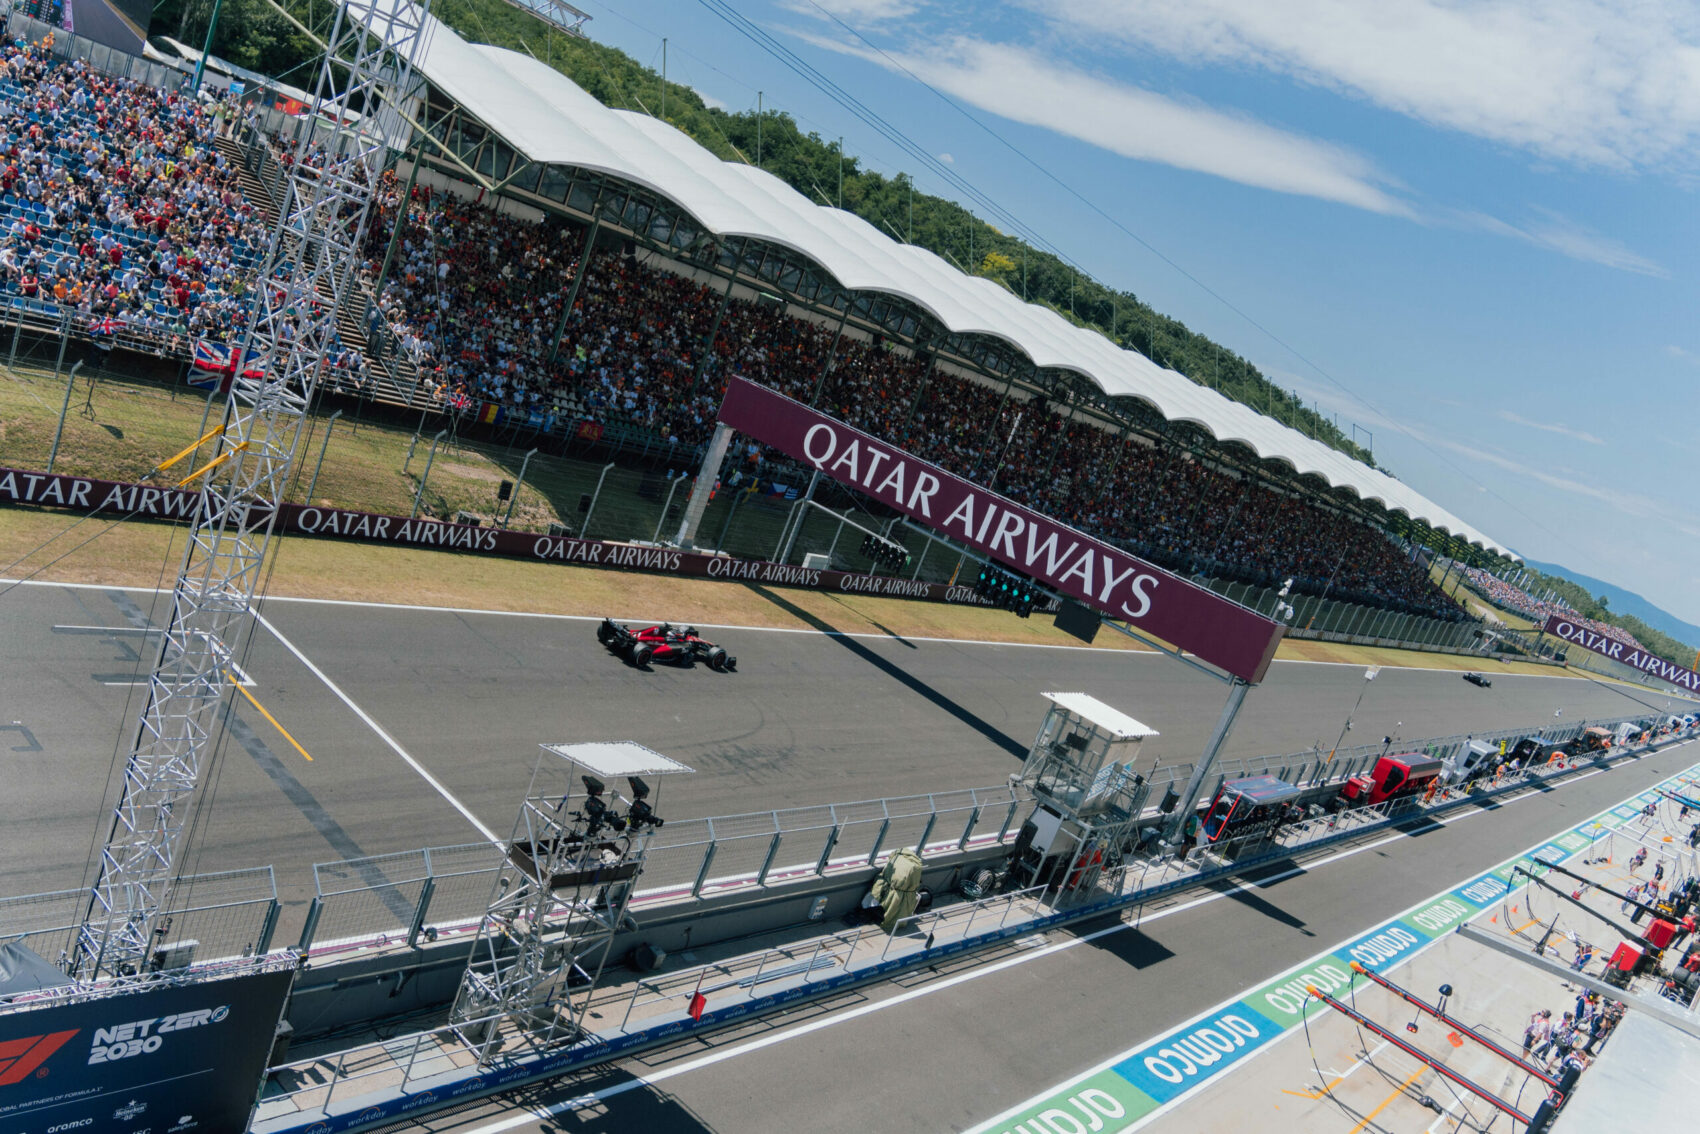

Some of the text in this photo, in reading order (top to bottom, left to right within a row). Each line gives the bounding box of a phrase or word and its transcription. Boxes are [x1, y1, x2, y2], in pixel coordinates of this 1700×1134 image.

[0, 471, 92, 507] ATAR
[297, 507, 498, 551] QATAR AIRWAYS
[803, 423, 1159, 618] QATAR AIRWAYS
[533, 536, 682, 571] QATAR AIRWAYS
[707, 557, 821, 587] QATAR AIRWAYS
[840, 574, 931, 598] QATAR AIRWAYS
[1556, 622, 1624, 659] QATAR
[1413, 899, 1468, 930] aramco
[1350, 927, 1418, 966] aramco
[93, 1017, 157, 1048] NET
[87, 1035, 163, 1066] 2030
[1143, 1014, 1260, 1084] aramco
[452, 1081, 487, 1095] workday
[499, 1069, 531, 1083] workday
[55, 1093, 65, 1102] OF
[65, 1087, 96, 1101] FORMULA
[402, 1094, 438, 1111] workday
[47, 1117, 94, 1134] aramco
[348, 1108, 387, 1127] workday
